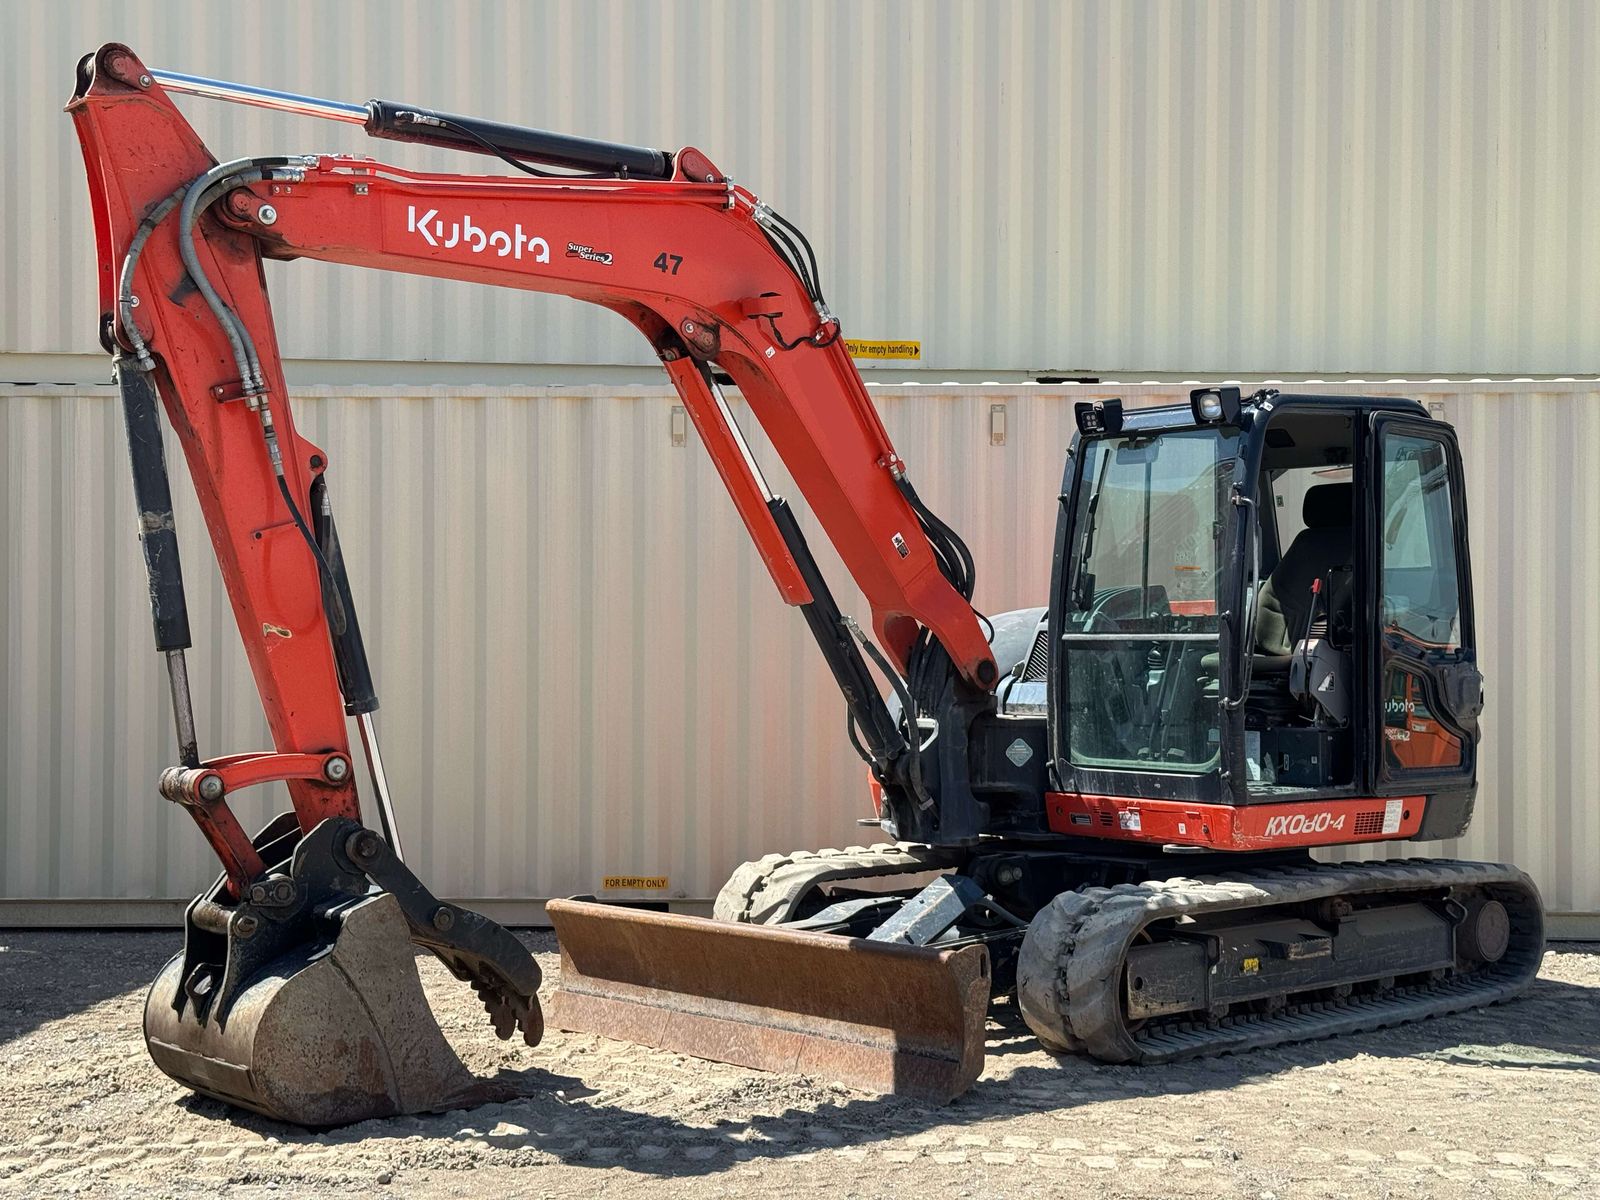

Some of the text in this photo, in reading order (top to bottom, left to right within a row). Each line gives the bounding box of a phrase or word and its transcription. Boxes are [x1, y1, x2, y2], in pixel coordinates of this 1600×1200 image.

[408, 205, 550, 264] Kubota
[568, 242, 593, 253] Super
[653, 252, 684, 275] 47
[860, 344, 868, 353] for
[869, 345, 886, 356] empty
[887, 345, 913, 356] handling
[1385, 698, 1414, 713] ubota
[605, 879, 666, 888] FOR EMPTY ONLY
